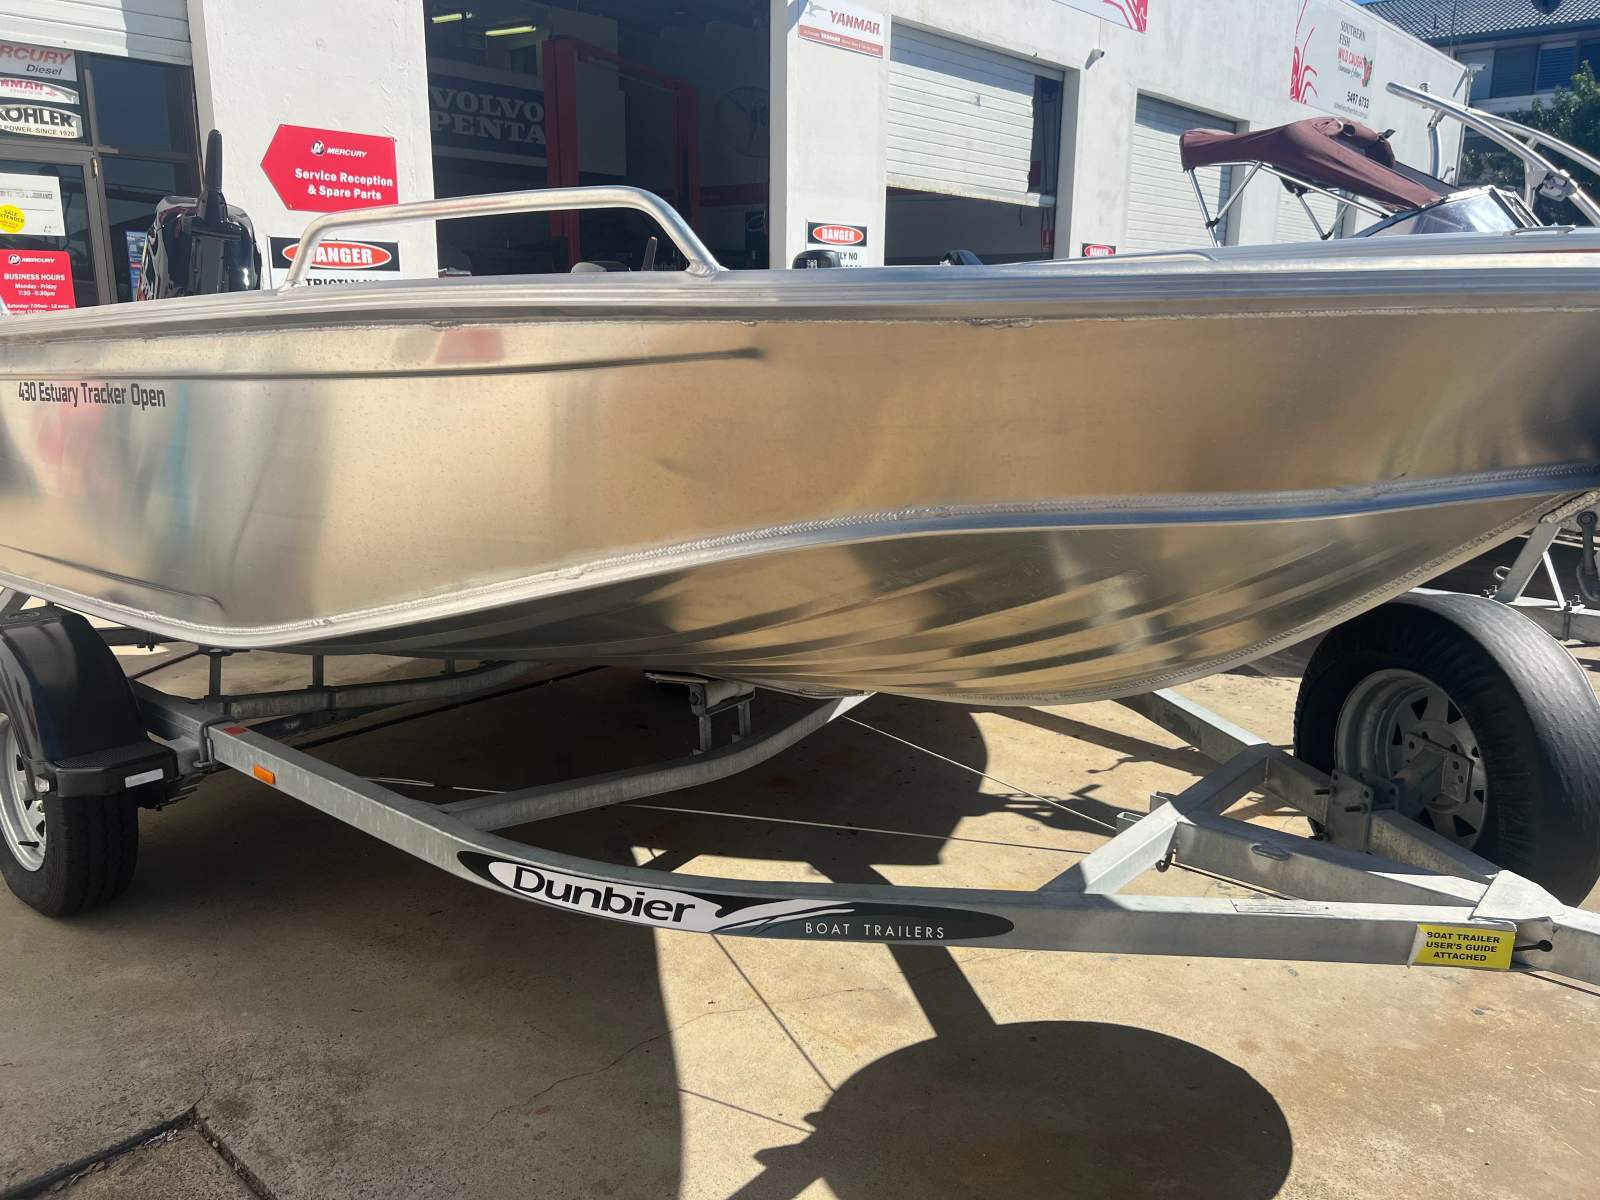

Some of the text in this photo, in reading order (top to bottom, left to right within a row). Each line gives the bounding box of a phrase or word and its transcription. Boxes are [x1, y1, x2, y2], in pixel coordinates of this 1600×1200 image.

[830, 10, 881, 35] YANMAR
[1341, 20, 1366, 41] SOUTHERN
[1340, 33, 1350, 48] FISH
[0, 44, 73, 64] RCURY
[26, 64, 62, 75] Diesel
[430, 86, 545, 123] VOLVO
[430, 110, 546, 145] PENTA
[326, 147, 367, 158] MERCURY
[295, 168, 393, 187] Service Reception
[307, 184, 382, 200] & Spare Parts
[822, 228, 855, 241] DANGER
[314, 246, 373, 264] ANGER
[18, 382, 166, 411] 430 Estuary Tracker Open
[512, 866, 696, 923] Dunbier
[805, 922, 945, 939] BOAT TRAILERS
[1456, 933, 1501, 944] TRAILER
[1425, 941, 1498, 953] USER'S GUIDE
[1433, 951, 1487, 962] ATTACHED
